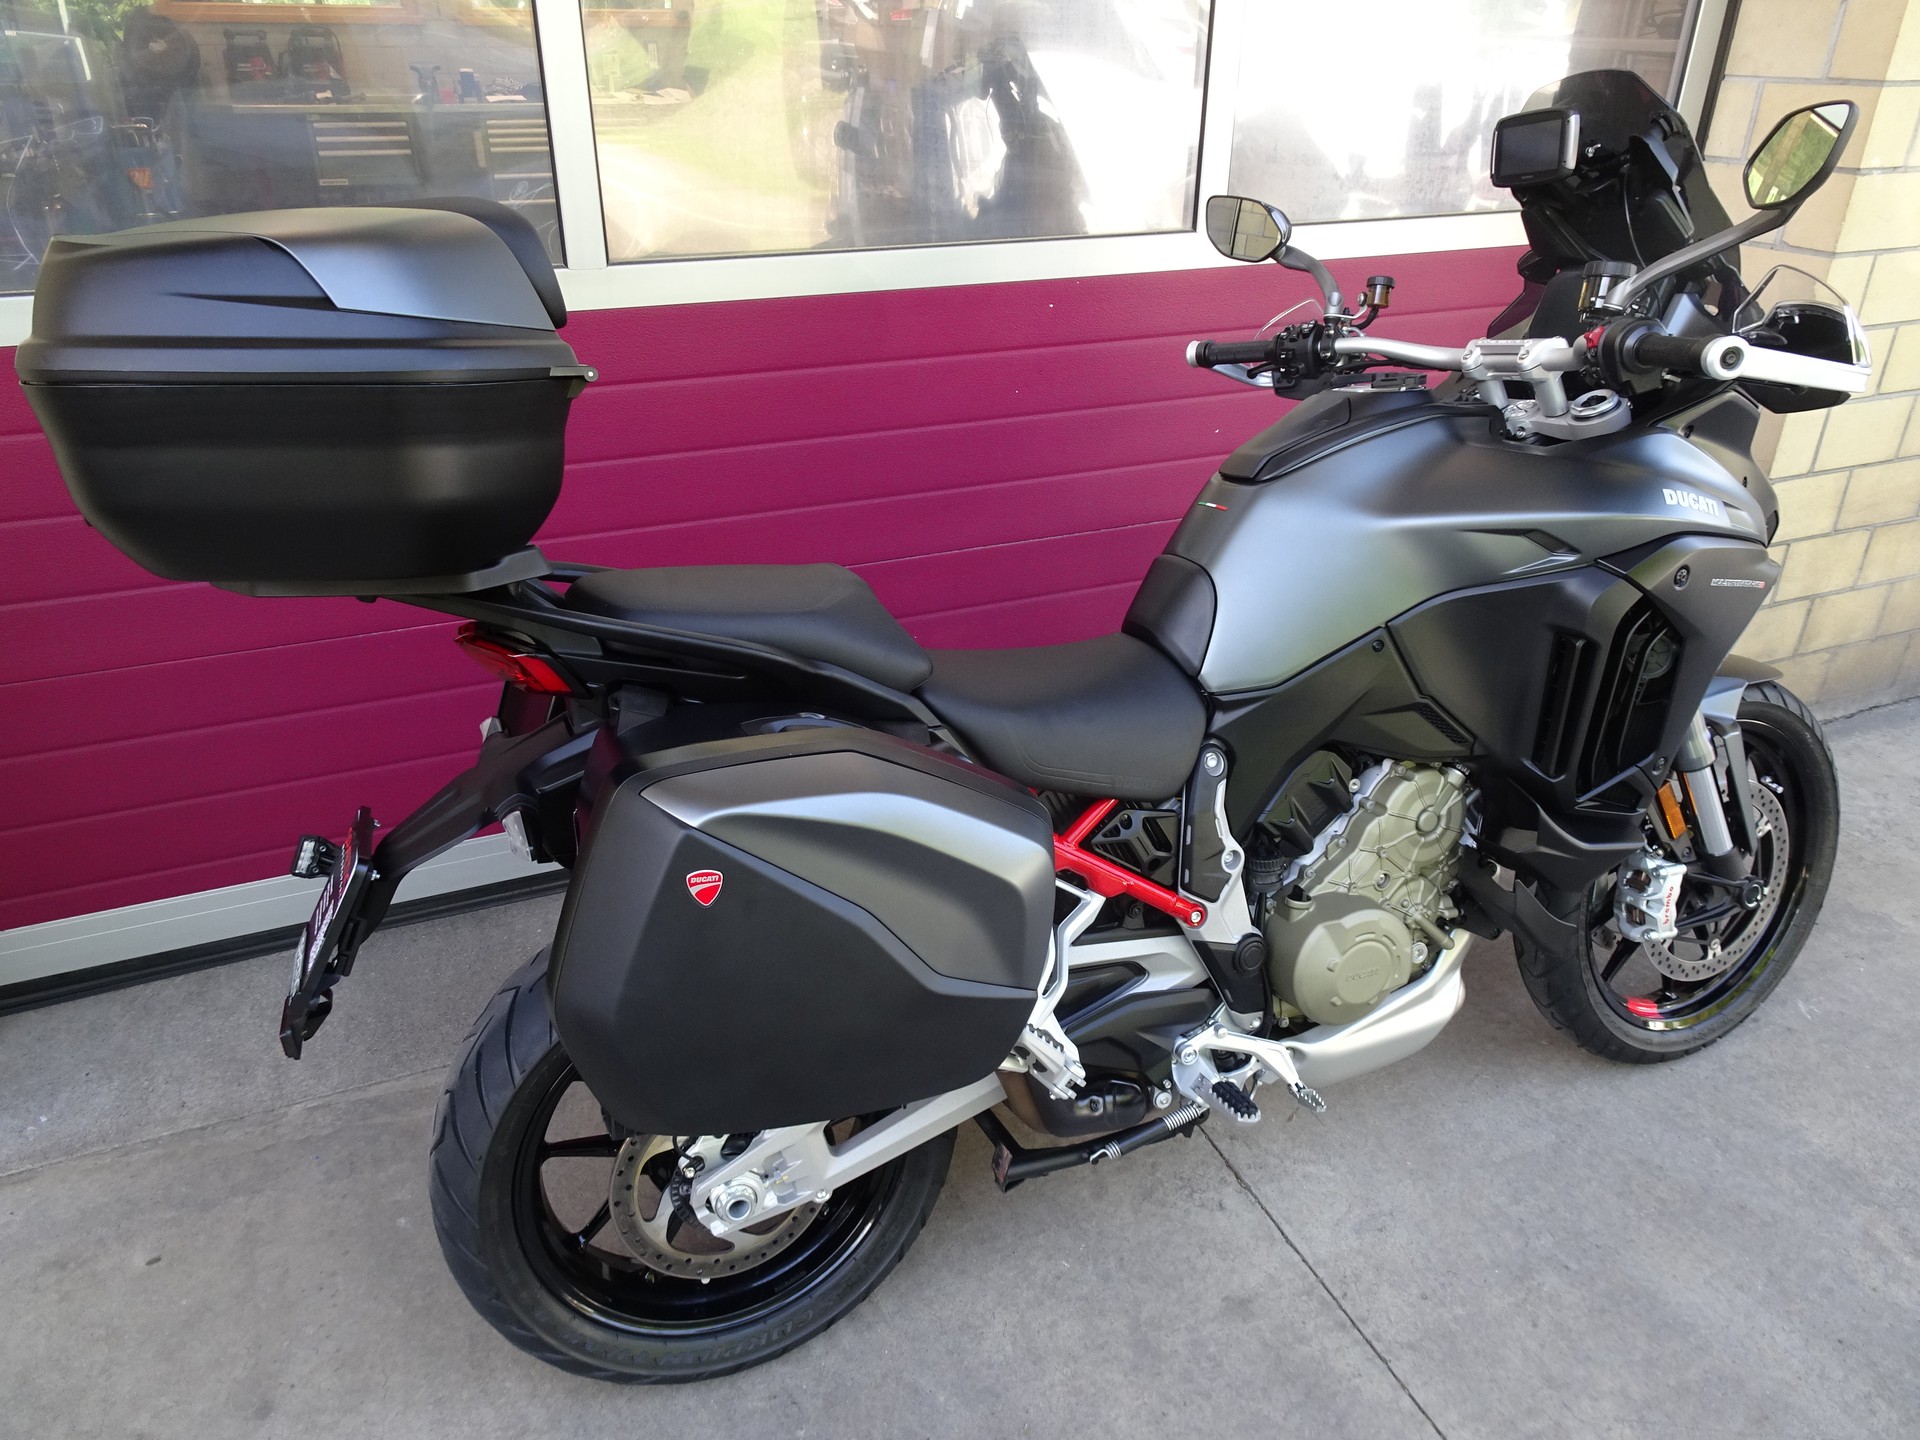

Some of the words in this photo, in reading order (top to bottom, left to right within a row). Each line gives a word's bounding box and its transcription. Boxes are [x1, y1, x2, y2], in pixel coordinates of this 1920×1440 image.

[1662, 488, 1719, 517] DUCATI
[690, 875, 719, 883] DUCATI
[1663, 886, 1674, 925] brembo
